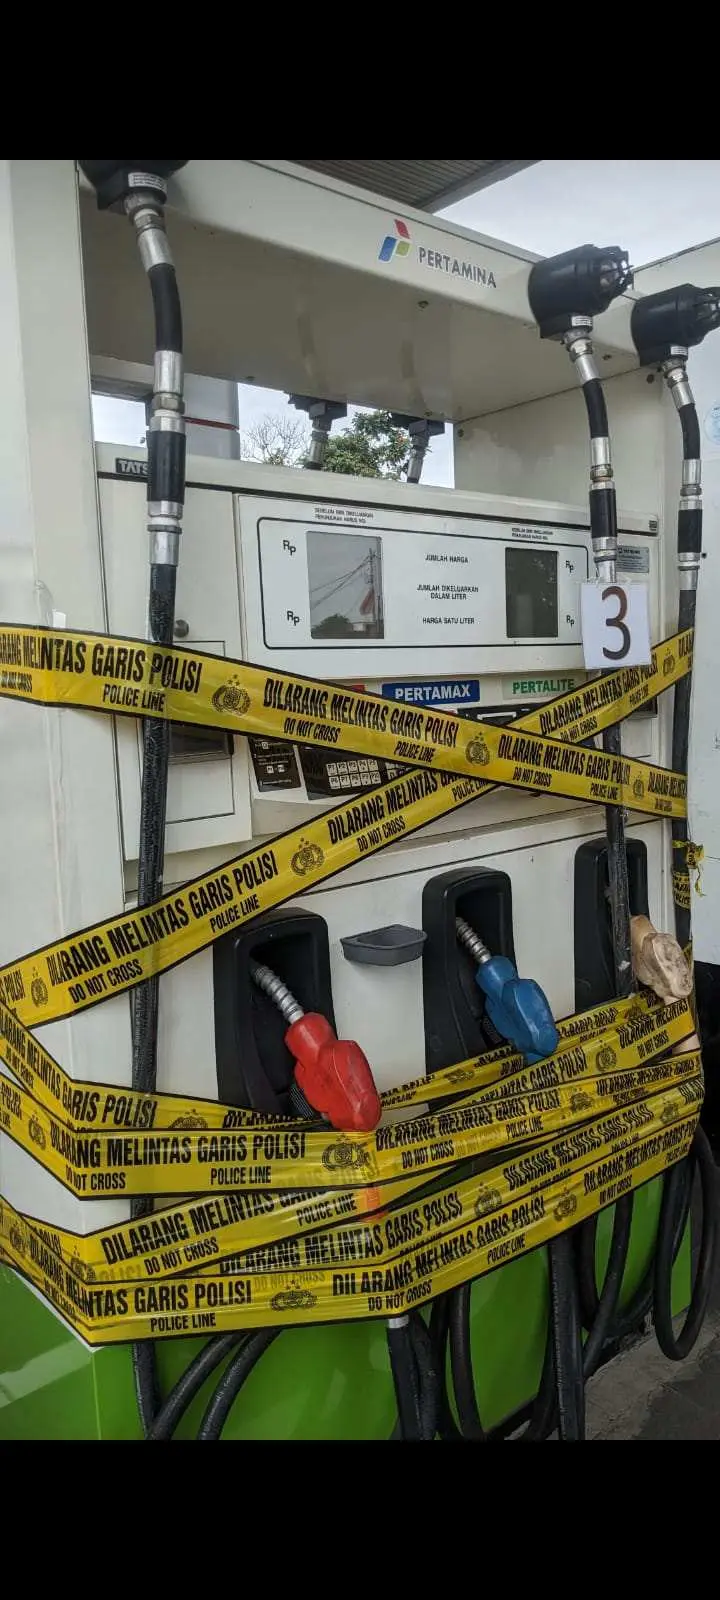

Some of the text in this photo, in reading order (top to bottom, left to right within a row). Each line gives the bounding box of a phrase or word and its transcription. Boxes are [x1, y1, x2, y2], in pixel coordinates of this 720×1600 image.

[418, 246, 497, 289] PERTAMINA
[283, 539, 297, 556] Rp
[425, 554, 469, 563] JUMLAH HARGA
[565, 560, 575, 573] Rp
[417, 584, 479, 593] JUMLAH DIKELUARKAN
[430, 592, 450, 600] DALAM
[286, 610, 300, 627] Rp
[422, 616, 442, 624] HARGA
[459, 617, 475, 625] LITER
[566, 614, 575, 628] Rp
[602, 586, 631, 660] 3
[23, 635, 87, 674] MELINTAS
[91, 643, 147, 683] GARIS
[150, 653, 203, 693] POLISI
[102, 683, 166, 713] POLICE LINE
[394, 684, 472, 702] PERTAMAX
[512, 679, 576, 695] PERTALITE
[539, 700, 584, 735] DILARANG
[583, 679, 623, 712] MELINTAS
[622, 667, 641, 693] GARIS
[263, 678, 459, 748] DILARANG MELINTAS GARIS POLISI
[569, 724, 582, 742] NOT
[580, 715, 598, 735] CROSS
[283, 717, 341, 744] DO NOT CROSS
[394, 741, 436, 763] POLICE LINE
[498, 734, 631, 785] DILARANG MELINTAS GARIS POLISI
[452, 778, 475, 802] POLICE
[513, 766, 552, 788] DO NOT CROSS
[589, 782, 618, 801] POLICE LINE
[326, 768, 439, 844] DILARANG MELINTAS
[356, 815, 406, 853] DO NOT CROSS
[46, 849, 279, 987] DILARANG MELINTAS GARIS POLISI
[210, 893, 260, 934] POLICE LINE
[67, 957, 143, 1004] DO NOT CROSS
[655, 1000, 689, 1025] MELINTAS
[645, 1036, 655, 1054] NOT
[654, 1030, 669, 1048] CROSS
[27, 1039, 158, 1128] MELINTAS GARIS POLISI
[530, 1061, 560, 1091] GARIS
[559, 1046, 587, 1079] POLISI
[375, 1116, 436, 1151] DILARANG
[437, 1103, 494, 1136] MELINTAS
[496, 1096, 527, 1122] GARIS
[528, 1087, 560, 1114] POLISI
[505, 1115, 544, 1140] POLICE LINE
[50, 1118, 101, 1169] DILARANG
[107, 1135, 192, 1167] MELINTAS
[197, 1134, 248, 1163] GARIS
[253, 1132, 306, 1160] POLISI
[401, 1150, 413, 1169] DO
[414, 1147, 428, 1166] NOT
[430, 1139, 455, 1161] CROSS
[503, 1148, 557, 1191] DILARANG
[552, 1126, 601, 1167] MELINTAS
[73, 1171, 87, 1191] NOT
[90, 1172, 126, 1191] CROSS
[210, 1165, 272, 1185] POLICE LINE
[584, 1156, 625, 1197] DILARANG
[624, 1134, 662, 1170] MELINTAS
[296, 1200, 333, 1227] POLICE
[335, 1192, 358, 1216] LINE
[101, 1212, 190, 1265] DILARANG
[189, 1190, 275, 1236] MELINTAS
[304, 1223, 384, 1266] MELINTAS
[385, 1208, 424, 1250] GARIS
[422, 1191, 464, 1231] POLISI
[144, 1257, 161, 1276] DO
[161, 1248, 184, 1271] NOT
[185, 1236, 220, 1262] CROSS
[332, 1260, 414, 1297] DILARANG
[415, 1230, 475, 1279] MELINTAS
[476, 1212, 511, 1248] GARIS
[510, 1195, 546, 1229] POLISI
[487, 1232, 526, 1264] POLICE LINE
[66, 1271, 129, 1318] MELINTAS
[134, 1283, 189, 1314] GARIS
[195, 1279, 252, 1309] POLISI
[368, 1279, 433, 1311] DO NOT CROSS
[150, 1312, 216, 1332] POLICE LINE
